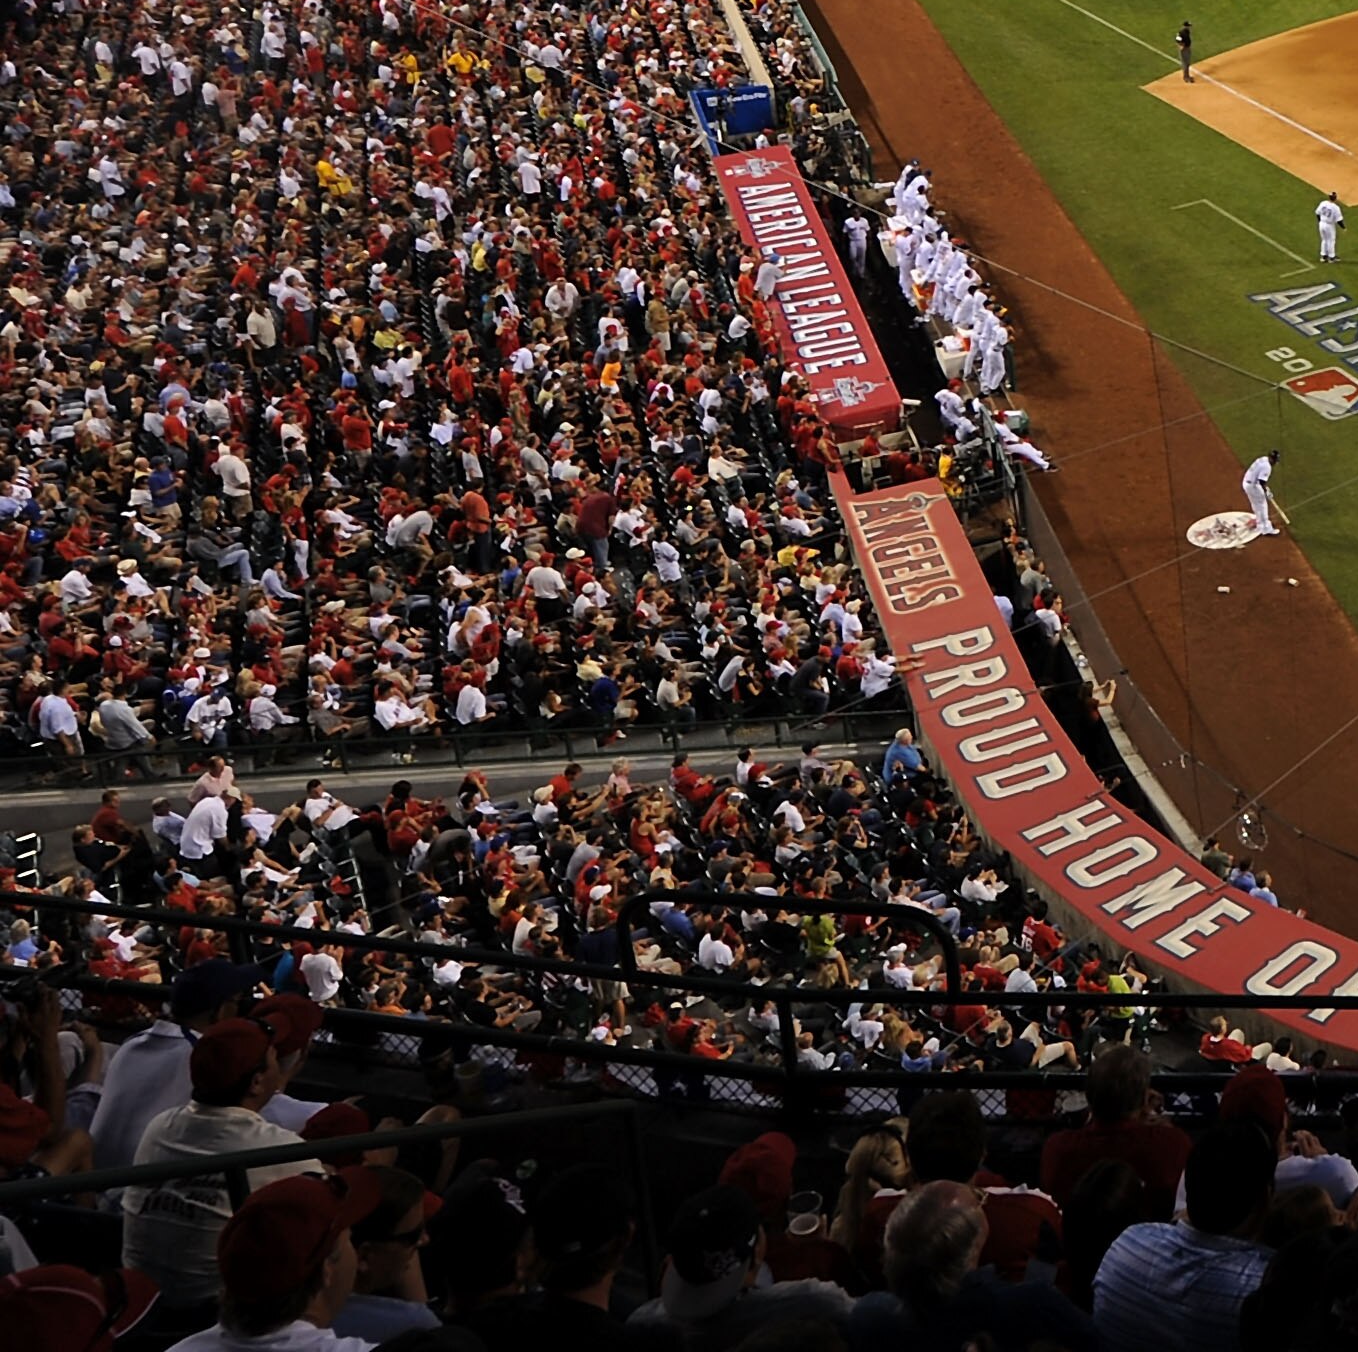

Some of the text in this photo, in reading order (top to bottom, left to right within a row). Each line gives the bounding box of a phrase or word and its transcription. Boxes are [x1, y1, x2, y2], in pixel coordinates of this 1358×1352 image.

[736, 181, 830, 284] AMERICAN
[773, 280, 869, 376] LEAGUE
[847, 491, 966, 616] ANGELS
[910, 624, 1070, 802] PROUD
[1019, 795, 1253, 962] HOME
